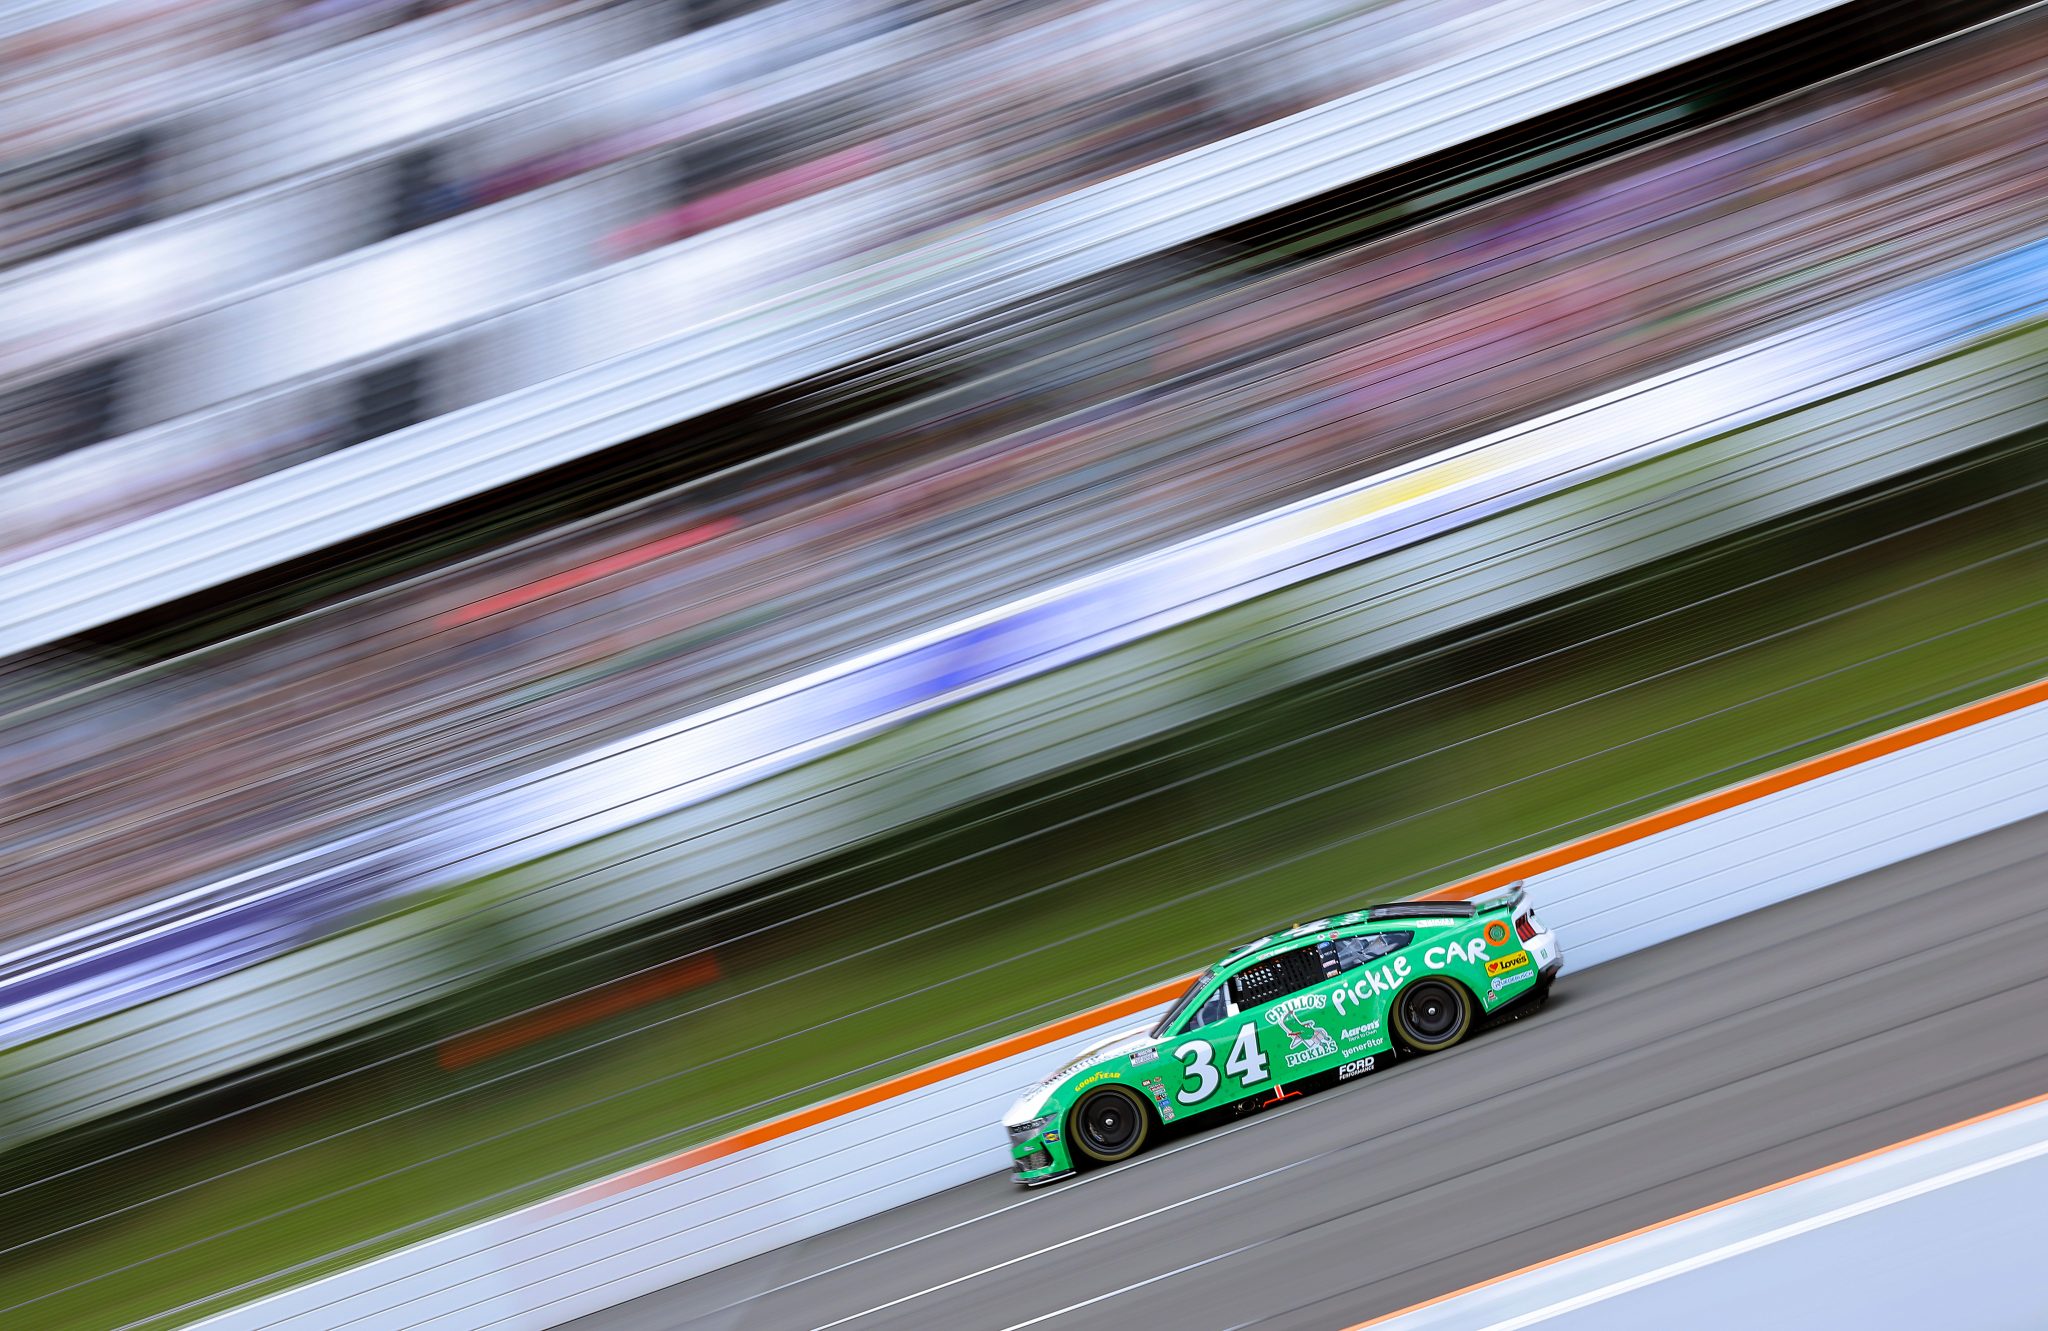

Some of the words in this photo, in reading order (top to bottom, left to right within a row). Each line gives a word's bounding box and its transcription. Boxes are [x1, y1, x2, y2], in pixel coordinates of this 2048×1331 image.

[1424, 938, 1490, 969] CAR
[1265, 994, 1326, 1024] GRILLO'S
[1173, 1020, 1270, 1105] 34
[1285, 1041, 1338, 1067] PICKLES
[1339, 1056, 1375, 1075] FORD
[1075, 1071, 1120, 1092] GOODYEAR
[1339, 1065, 1375, 1080] PERFORMANCE
